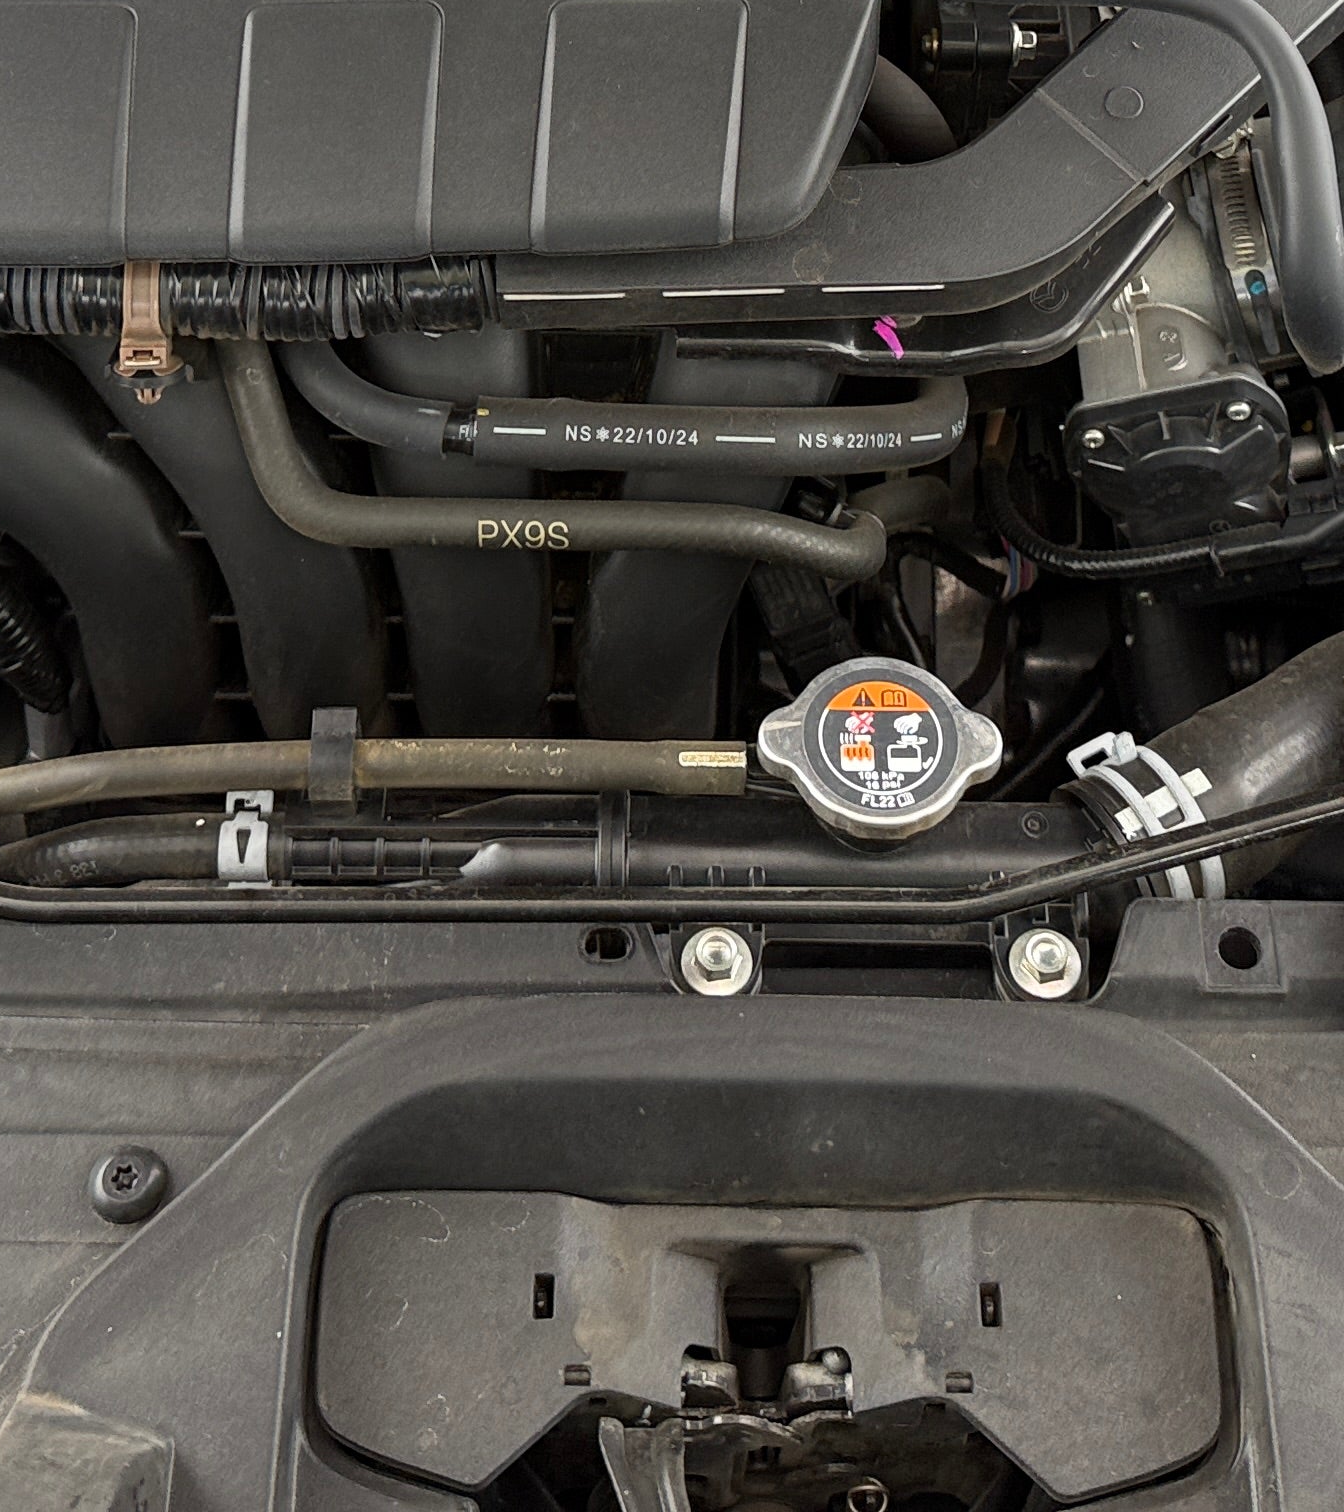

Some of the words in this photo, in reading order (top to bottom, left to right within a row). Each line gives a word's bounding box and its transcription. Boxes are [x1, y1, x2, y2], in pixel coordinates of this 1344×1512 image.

[477, 519, 570, 550] PX9S
[881, 770, 905, 782] kPa
[860, 793, 896, 808] FL22
